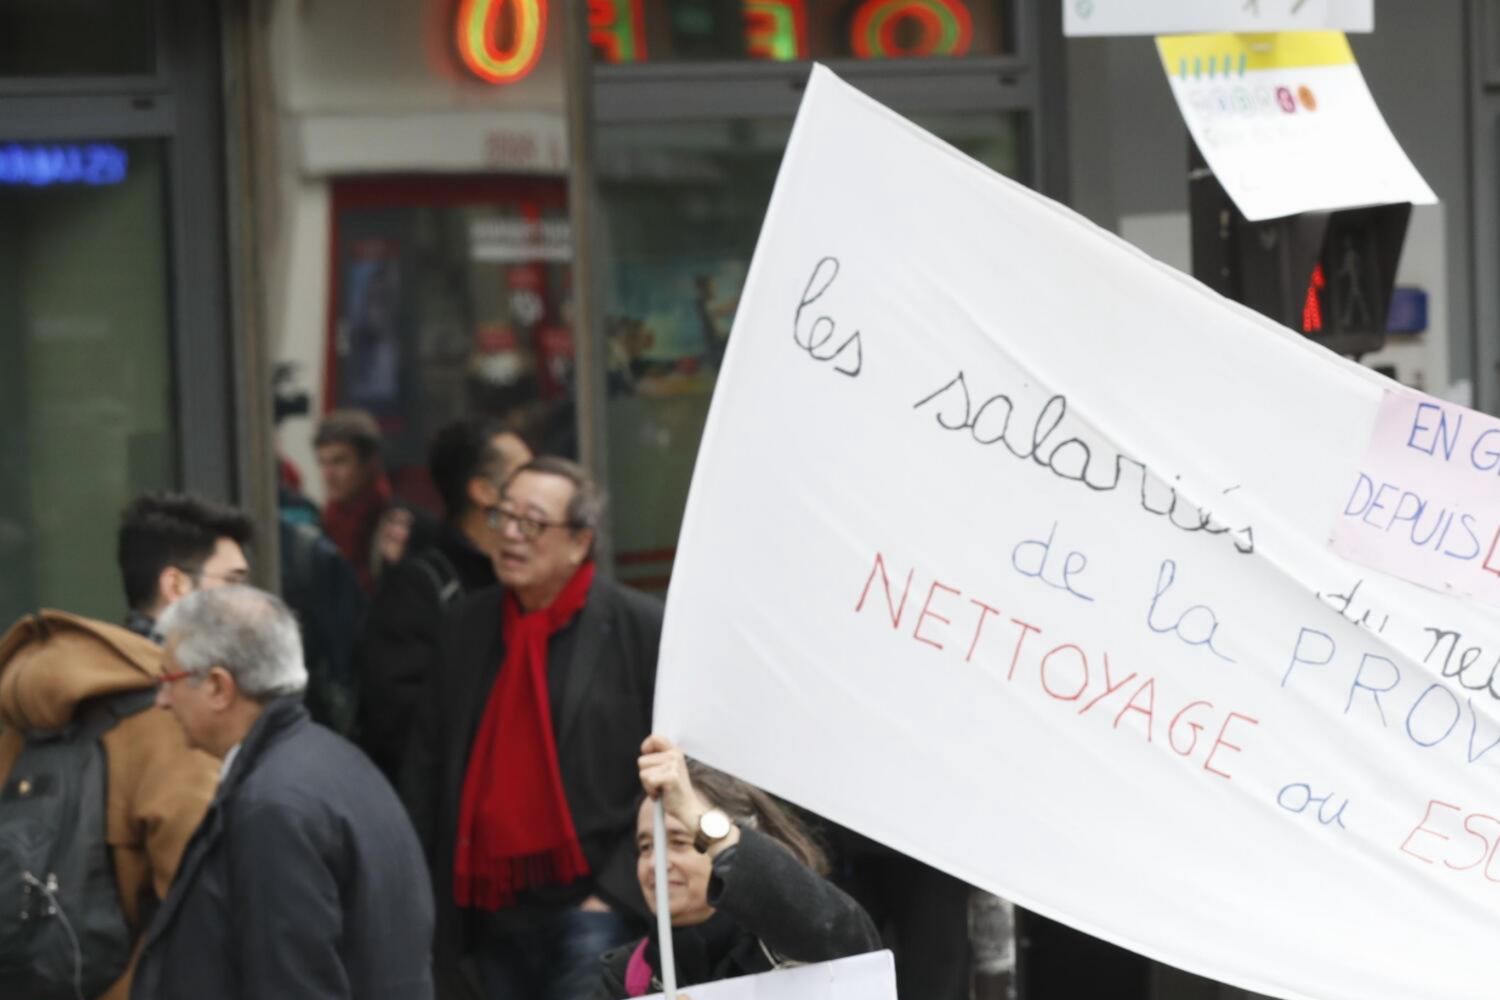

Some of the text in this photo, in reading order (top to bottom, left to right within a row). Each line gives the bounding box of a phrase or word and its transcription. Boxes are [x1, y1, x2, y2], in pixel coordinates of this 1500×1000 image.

[794, 257, 862, 376] les
[1407, 402, 1463, 462] EN
[1344, 472, 1481, 561] DEPUIS
[1011, 521, 1094, 602] de
[1147, 559, 1236, 664] la
[855, 551, 1260, 780] NETTOYAGE
[1277, 783, 1349, 830] ou
